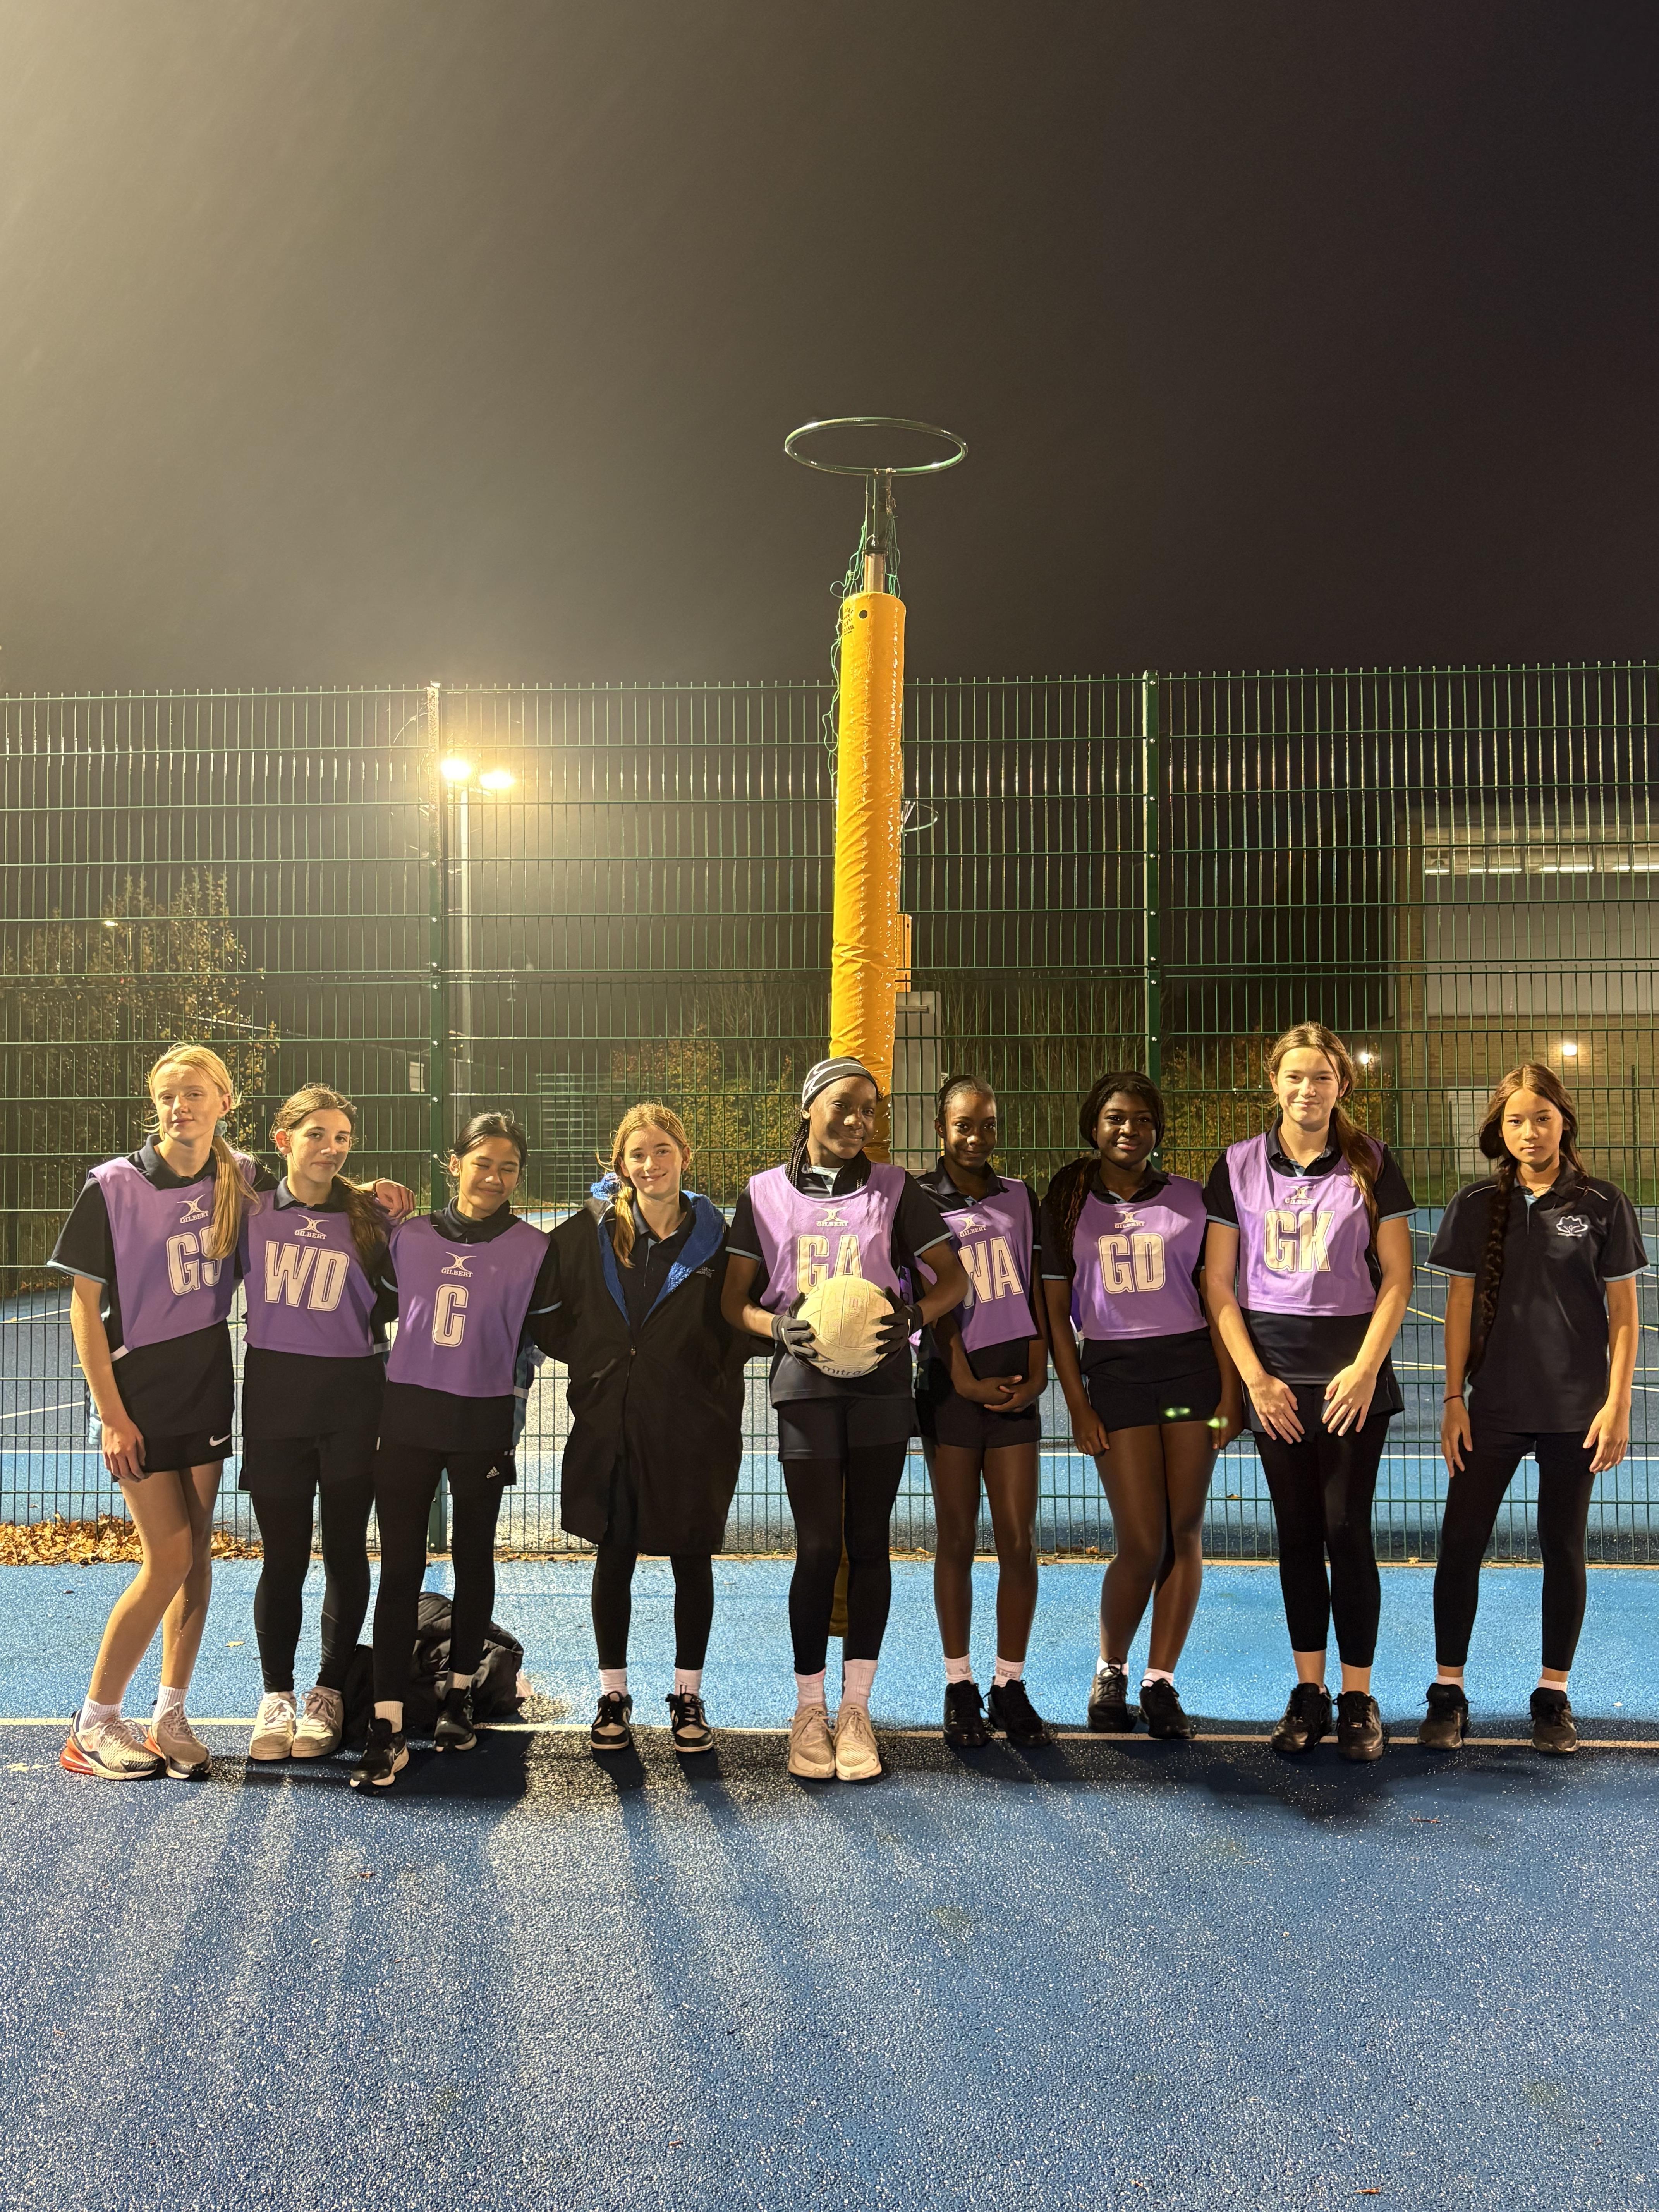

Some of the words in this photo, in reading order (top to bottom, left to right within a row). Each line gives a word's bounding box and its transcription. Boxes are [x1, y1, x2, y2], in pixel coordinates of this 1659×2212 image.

[180, 1211, 209, 1223] GILBERT
[295, 1231, 327, 1240] GILBERT
[959, 1226, 986, 1237] GILBERT
[1264, 1209, 1335, 1273] GK
[166, 1224, 222, 1296] GS
[265, 1240, 350, 1312] WD
[441, 1268, 473, 1278] GILBERT
[797, 1234, 863, 1295] GA
[1098, 1233, 1166, 1294] GD
[432, 1283, 469, 1348] C
